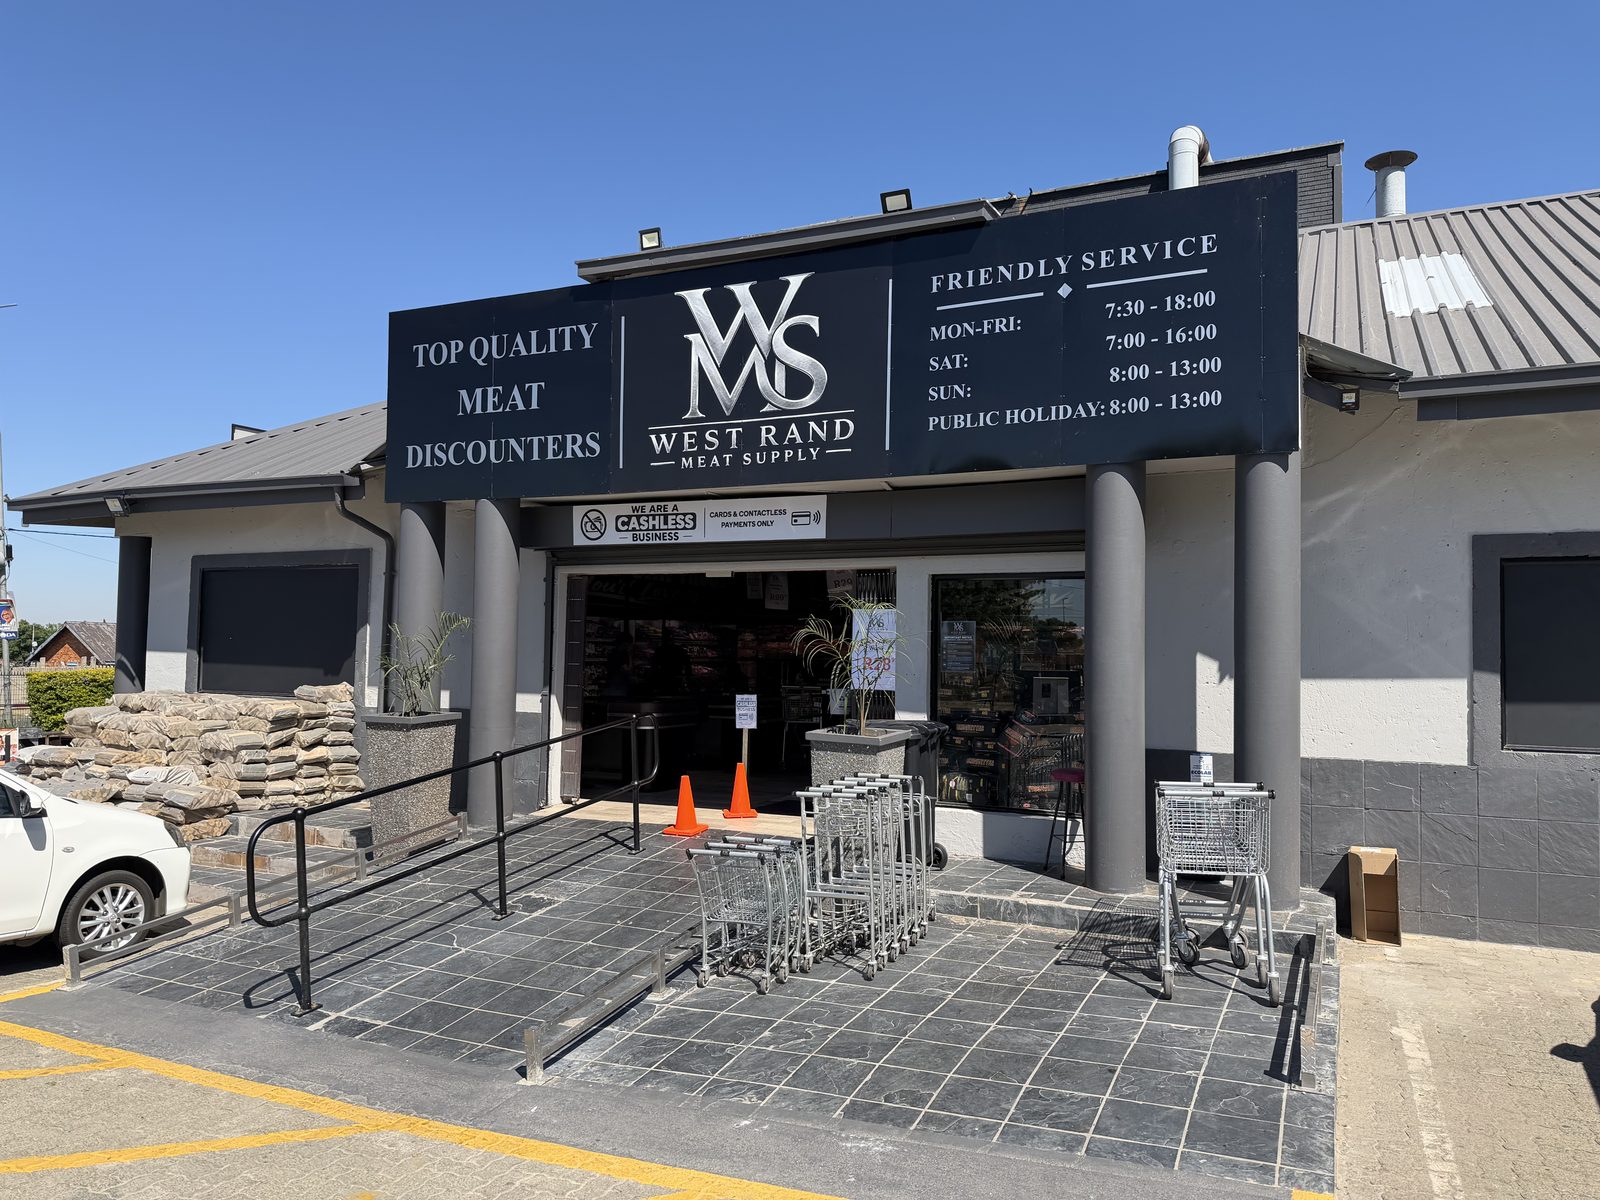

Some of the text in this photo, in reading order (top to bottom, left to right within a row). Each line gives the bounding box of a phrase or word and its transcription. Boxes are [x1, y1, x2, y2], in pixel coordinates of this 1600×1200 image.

[931, 233, 1218, 293] FRIENDLY SERVICE
[1105, 299, 1145, 319] 7:30
[1164, 290, 1216, 312] 18:00
[929, 316, 1022, 342] MON-FRI:
[1105, 331, 1146, 351] 7:00
[1165, 323, 1217, 345] 16:00
[412, 322, 599, 368] TOP QUALITY
[929, 353, 968, 372] SAT:
[1109, 363, 1150, 383] 8:00
[1170, 356, 1222, 377] 13:00
[457, 381, 545, 416] MEAT
[928, 383, 972, 402] SUN:
[1109, 396, 1150, 415] 8:00
[1170, 389, 1222, 410] 13:00
[928, 401, 1105, 432] PUBLIC HOLIDAY:
[649, 417, 855, 455] WEST RAND
[405, 431, 601, 469] DISCOUNTERS
[681, 447, 821, 469] MEAT SUPPLY
[631, 503, 679, 514] WE ARE A
[709, 508, 787, 519] CARDS & CONTACTLESS
[617, 514, 695, 531] CASHLESS
[720, 519, 775, 529] PAYMENTS ONLY
[631, 531, 680, 543] BUSINESS
